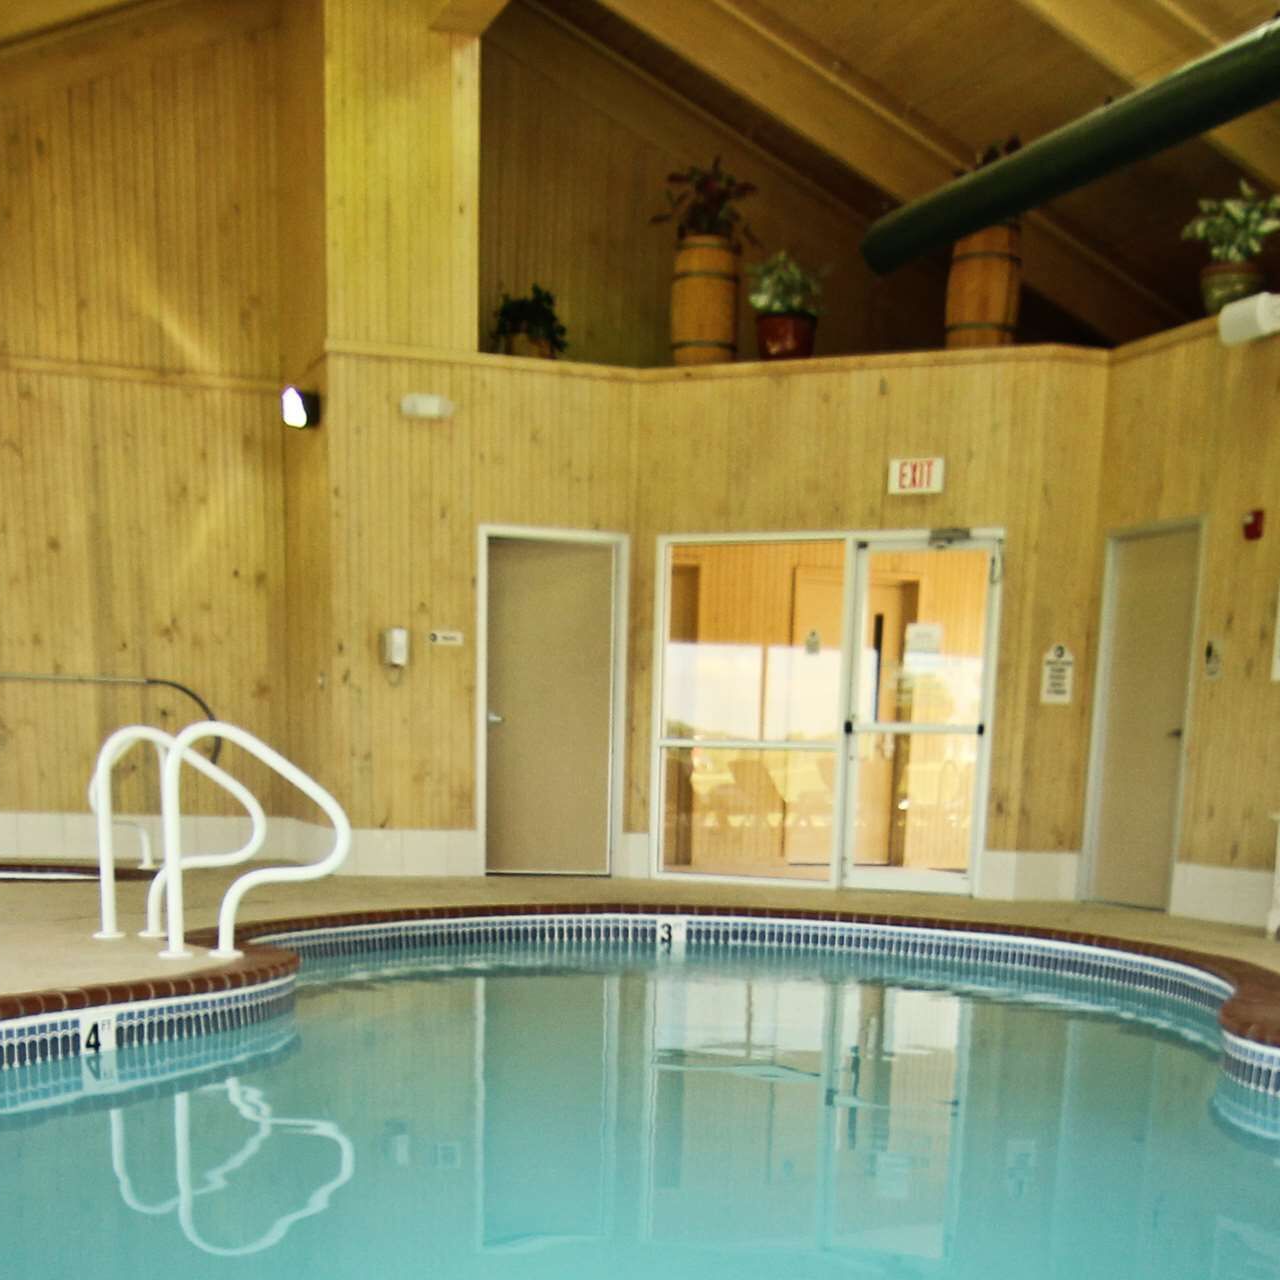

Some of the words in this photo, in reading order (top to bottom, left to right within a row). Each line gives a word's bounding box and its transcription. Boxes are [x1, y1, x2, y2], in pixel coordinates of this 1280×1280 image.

[899, 459, 933, 489] EXIT
[660, 922, 672, 944] 3
[85, 1021, 101, 1053] 4
